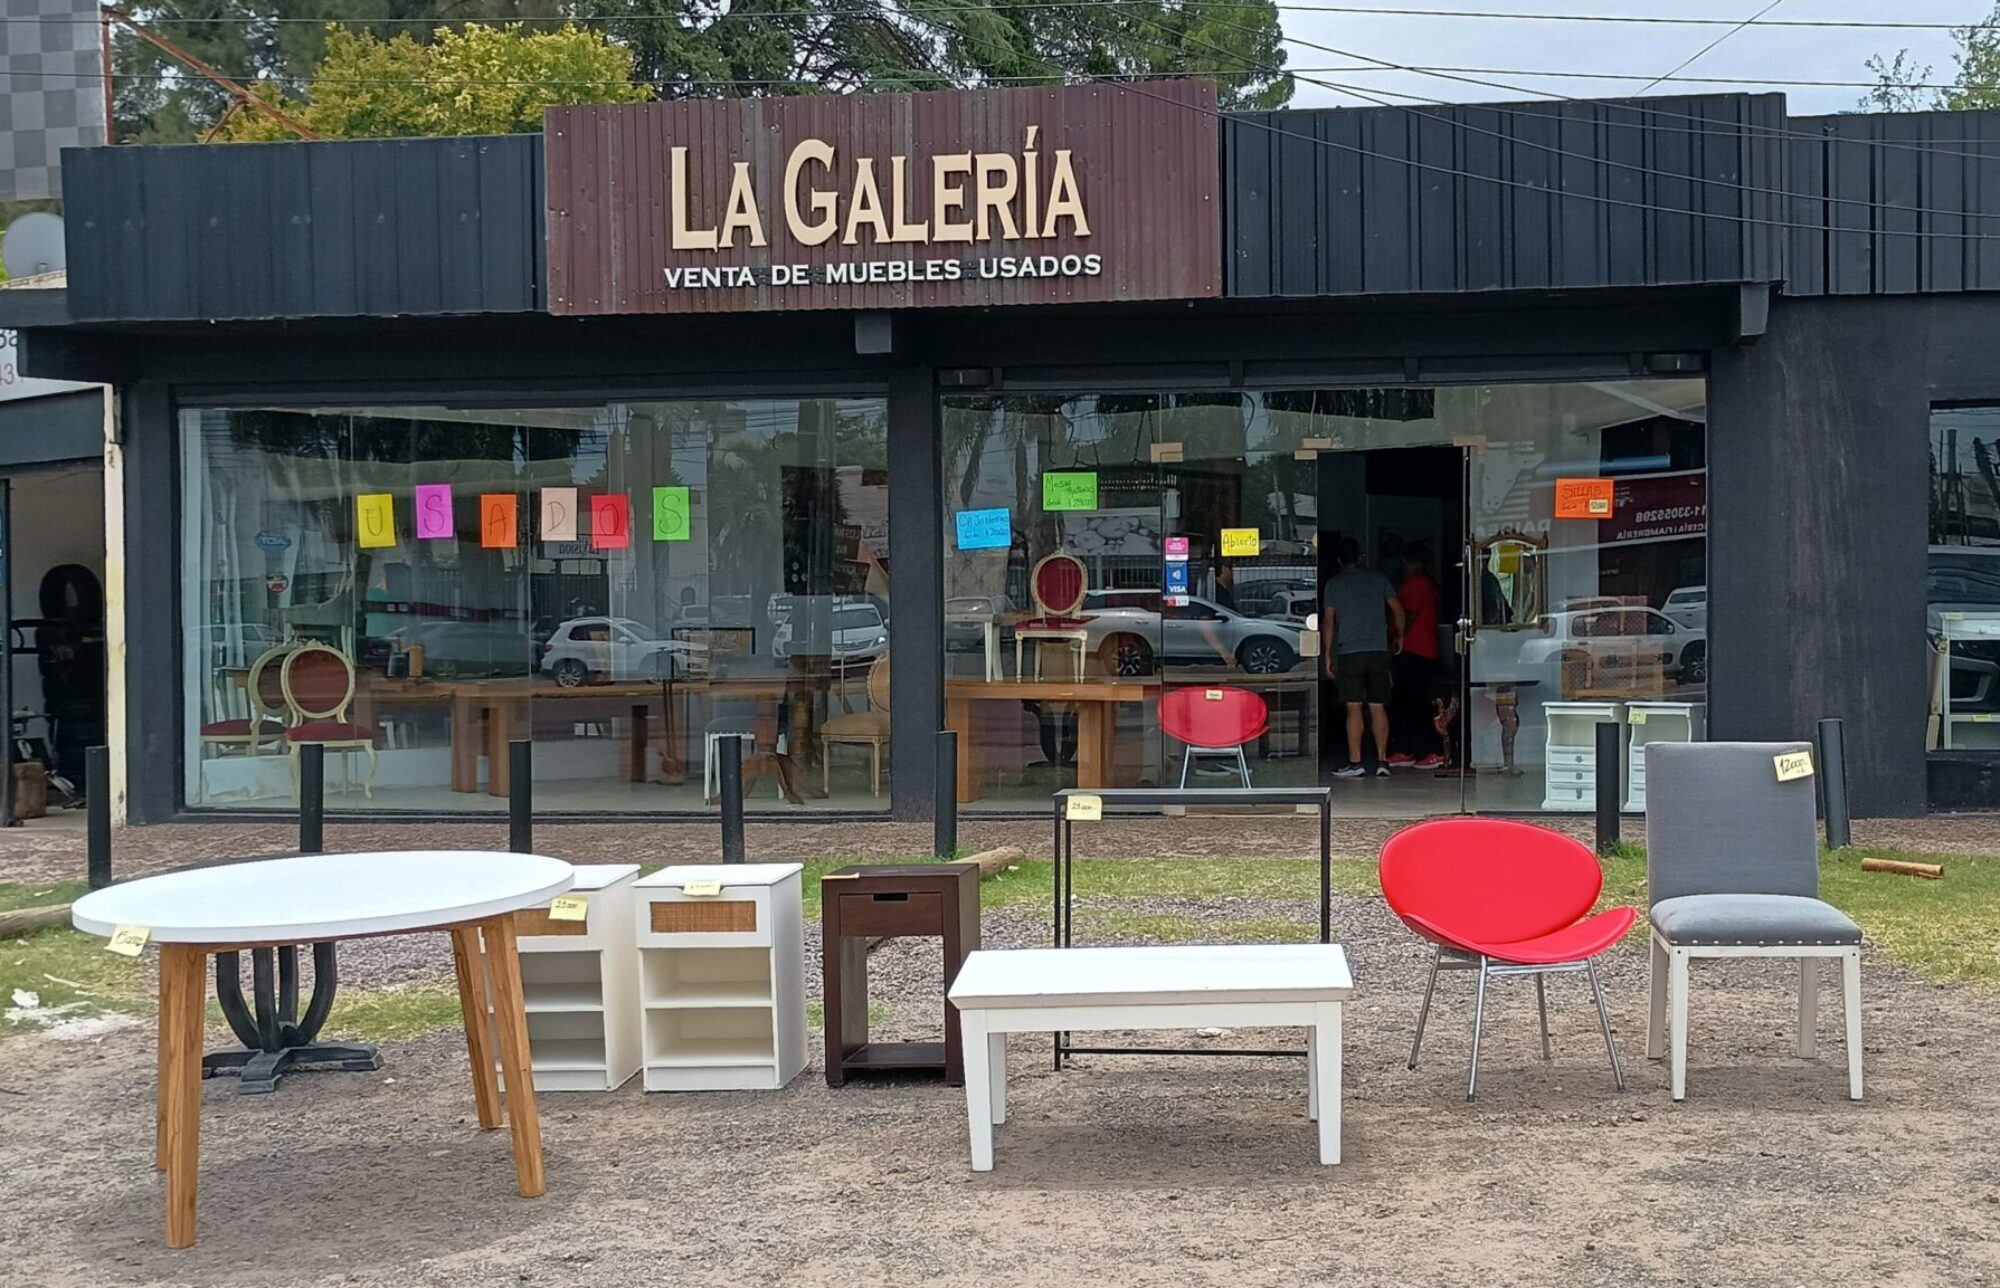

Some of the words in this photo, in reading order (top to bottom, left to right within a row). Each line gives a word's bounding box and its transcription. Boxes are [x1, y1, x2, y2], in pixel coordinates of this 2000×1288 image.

[671, 146, 767, 252] LA
[784, 125, 1092, 247] GALERÍA
[664, 267, 757, 289] VENTA
[771, 264, 810, 286] DE
[826, 258, 962, 285] MUEBLES
[978, 254, 1103, 280] USADOS
[1223, 533, 1257, 553] Abierto
[1168, 585, 1186, 593] VISA
